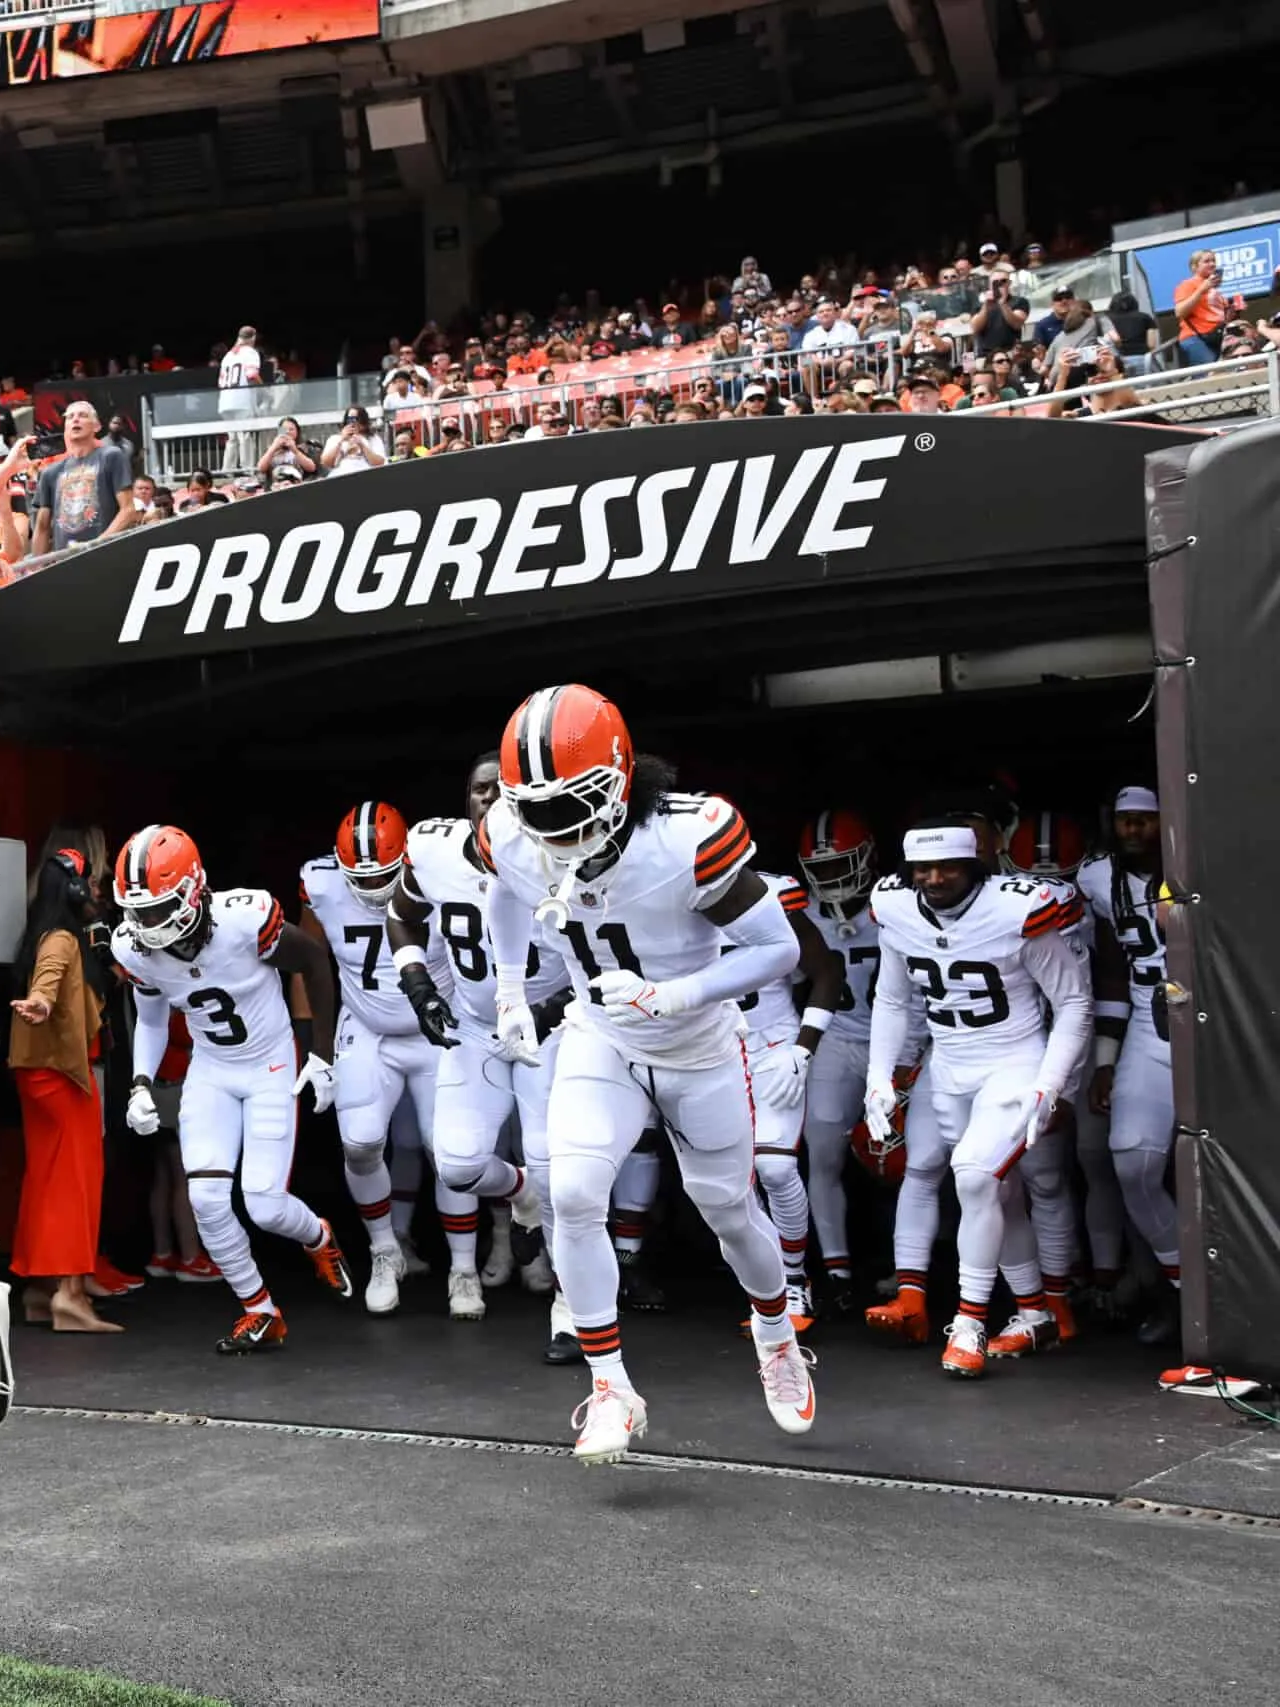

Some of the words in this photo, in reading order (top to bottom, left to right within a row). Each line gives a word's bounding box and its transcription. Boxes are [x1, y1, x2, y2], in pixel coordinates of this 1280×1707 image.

[118, 434, 907, 644] PROGRESSIVE
[559, 920, 645, 1007] 11
[906, 956, 1010, 1028] 23
[187, 987, 248, 1046] 3
